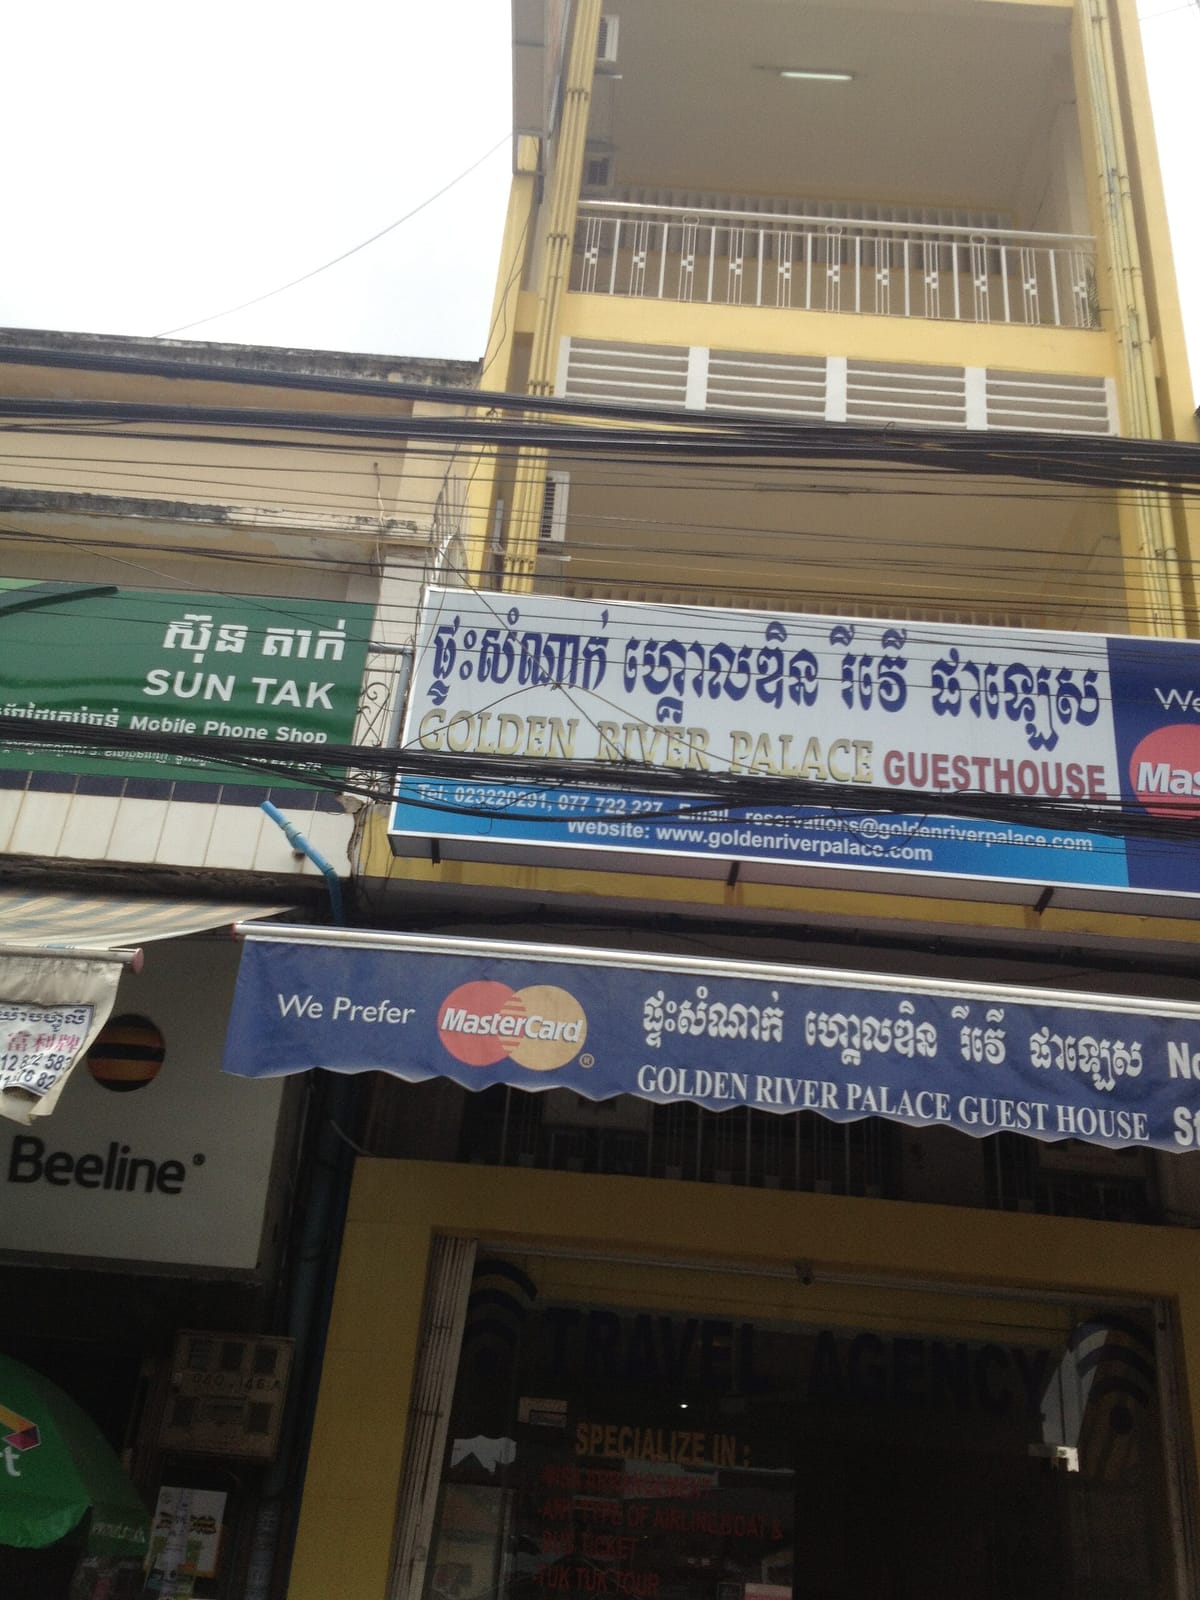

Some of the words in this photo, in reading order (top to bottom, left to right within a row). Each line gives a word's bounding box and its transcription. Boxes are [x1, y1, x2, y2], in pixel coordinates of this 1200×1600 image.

[143, 669, 235, 702] SUN
[252, 677, 335, 709] TAK
[130, 714, 196, 734] Mobile
[203, 720, 269, 740] Phone
[276, 726, 328, 744] Shop
[418, 708, 580, 759] GOLDEN
[595, 720, 710, 771] RIVER
[728, 730, 874, 784] PALACE
[883, 749, 1108, 800] GUESTHOUSE
[558, 795, 590, 812] 077
[595, 797, 626, 815] 722
[568, 820, 650, 839] Website:
[656, 827, 933, 861] www.goldenriverpalace.com
[278, 994, 323, 1020] We
[332, 996, 416, 1025] Prefer
[440, 1008, 583, 1043] MasterCard
[637, 1064, 748, 1099] GOLDEN
[756, 1075, 840, 1111] RIVER
[846, 1083, 951, 1121] PALACE
[958, 1095, 1049, 1131] GUEST
[1056, 1105, 1149, 1141] HOUSE
[8, 1134, 187, 1195] Beeline
[544, 1306, 770, 1396] TRAVEL
[808, 1330, 1052, 1415] AGENCY
[575, 1421, 705, 1466] SPECIALIZE
[712, 1433, 737, 1468] IN
